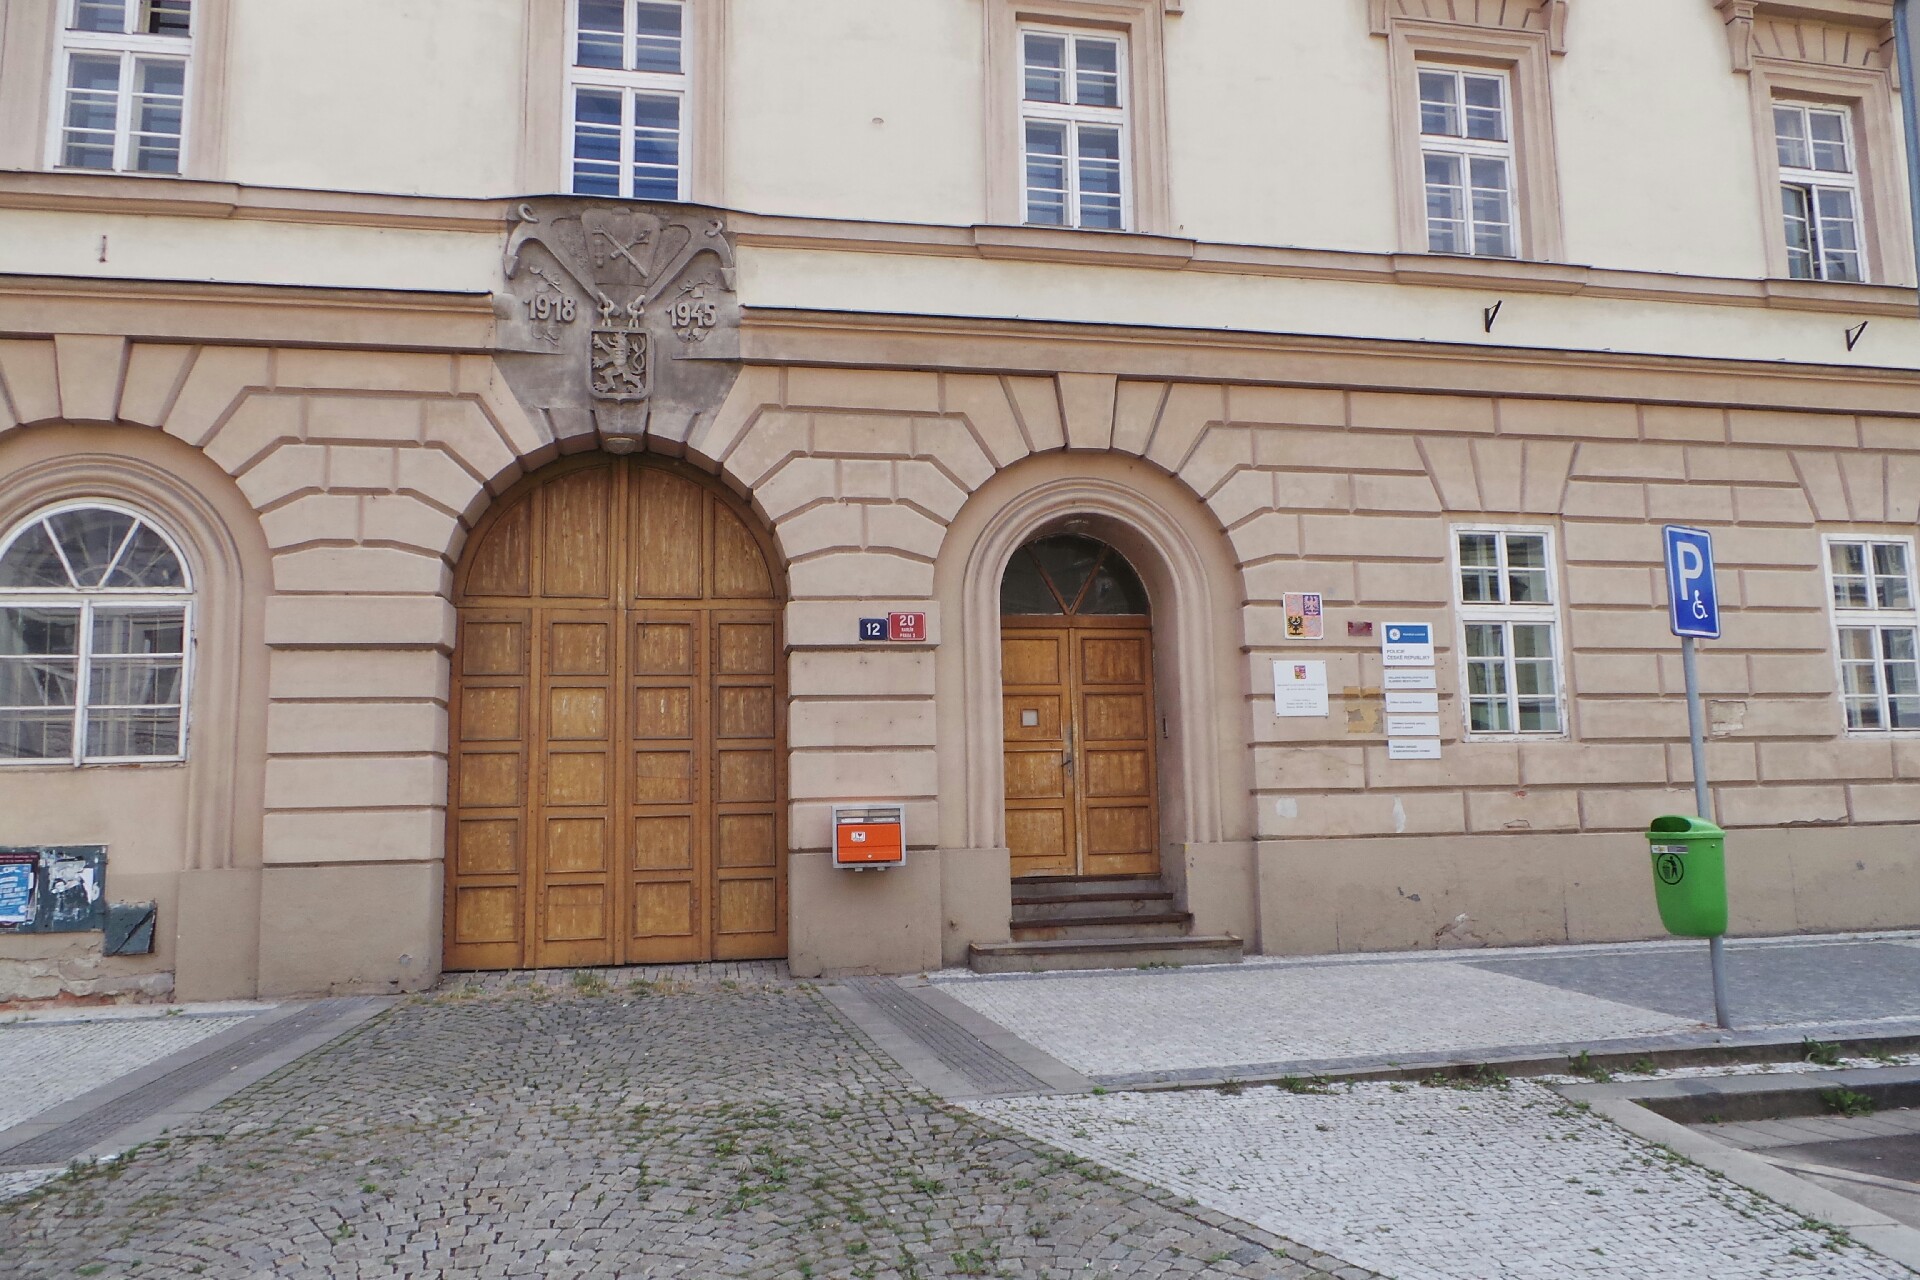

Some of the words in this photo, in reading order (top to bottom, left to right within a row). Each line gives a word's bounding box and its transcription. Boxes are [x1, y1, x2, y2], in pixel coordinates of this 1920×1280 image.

[524, 294, 577, 322] 1918
[666, 302, 717, 327] 1945
[1676, 541, 1704, 601] P
[866, 622, 881, 636] 12
[899, 614, 915, 626] 20
